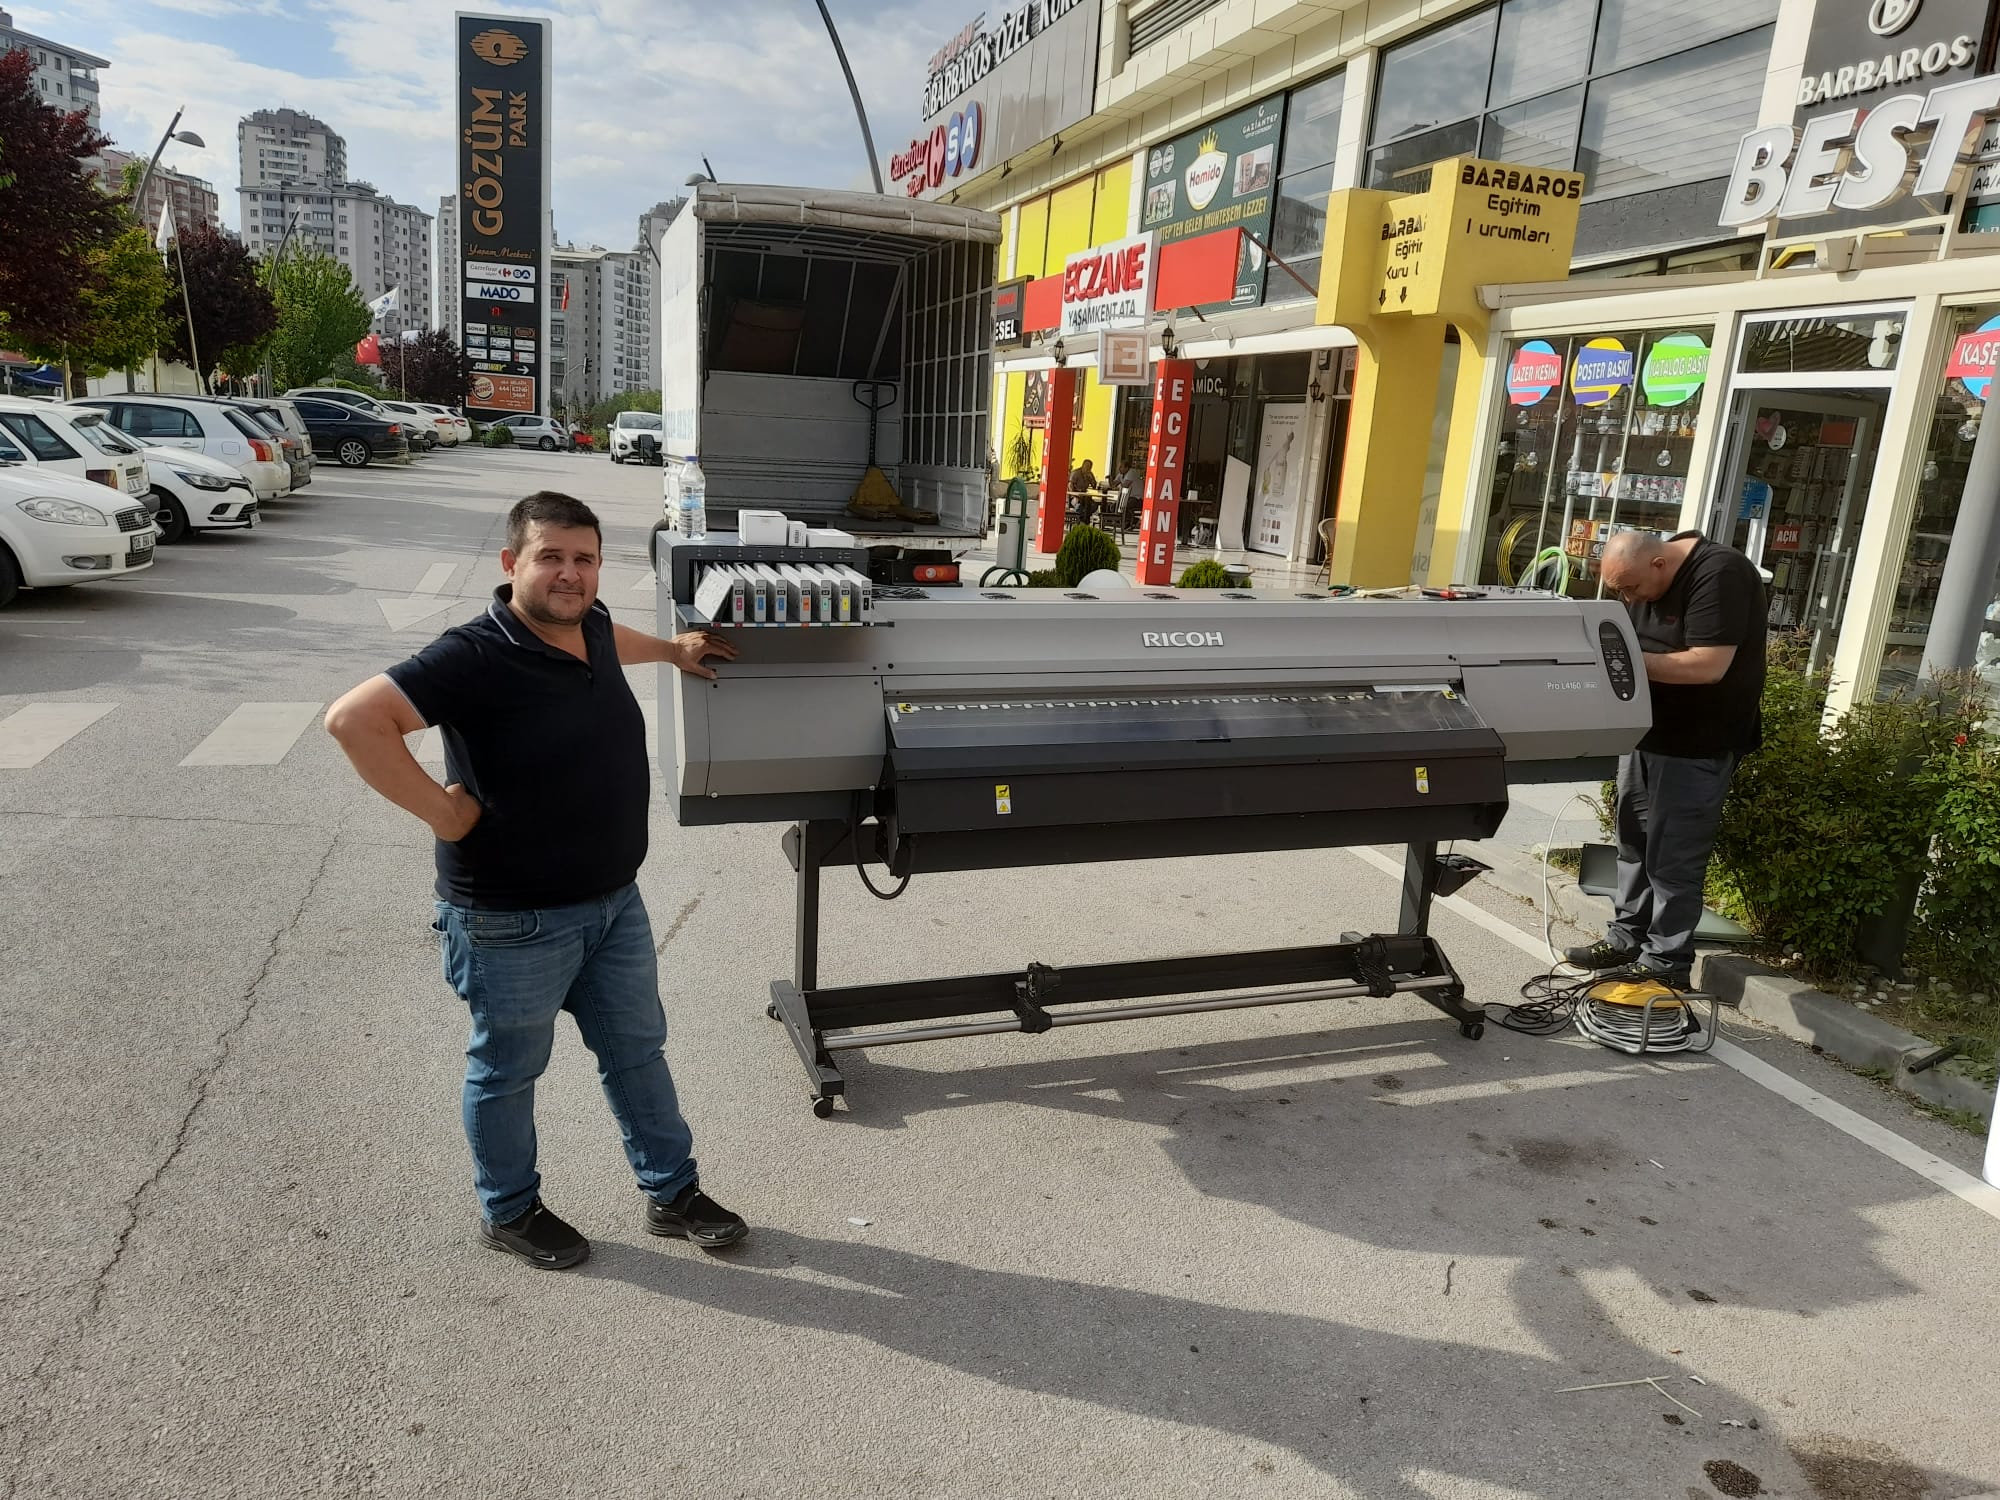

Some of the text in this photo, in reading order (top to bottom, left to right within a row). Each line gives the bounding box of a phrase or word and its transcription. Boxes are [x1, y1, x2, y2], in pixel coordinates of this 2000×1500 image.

[930, 37, 992, 116] BARBAROS
[995, 4, 1031, 64] ÖZEL
[1797, 35, 1970, 105] BARBAROS
[509, 90, 527, 148] PARK
[464, 87, 504, 236] GÖZÜM
[1717, 73, 2000, 227] BEST
[1461, 165, 1581, 199] BARBAROS
[1973, 175, 2000, 192] A4/
[1243, 196, 1269, 218] LEZZET
[1381, 214, 1427, 241] BARBA
[1064, 242, 1146, 303] ECZANE
[480, 285, 520, 300] MADO
[1068, 299, 1136, 331] YAŞAMKENT ATA
[473, 362, 506, 372] SUBWAY
[1577, 359, 1630, 381] POSTER BASKI
[1649, 353, 1709, 377] KATALOG BASK
[1958, 342, 2000, 374] KAŞE
[1512, 365, 1534, 383] LAZER
[1139, 378, 1164, 562] ECZANE
[1153, 379, 1184, 565] ECZANE
[1776, 530, 1798, 543] AÇIK
[1142, 631, 1224, 647] RICOH
[1547, 682, 1559, 690] Pro
